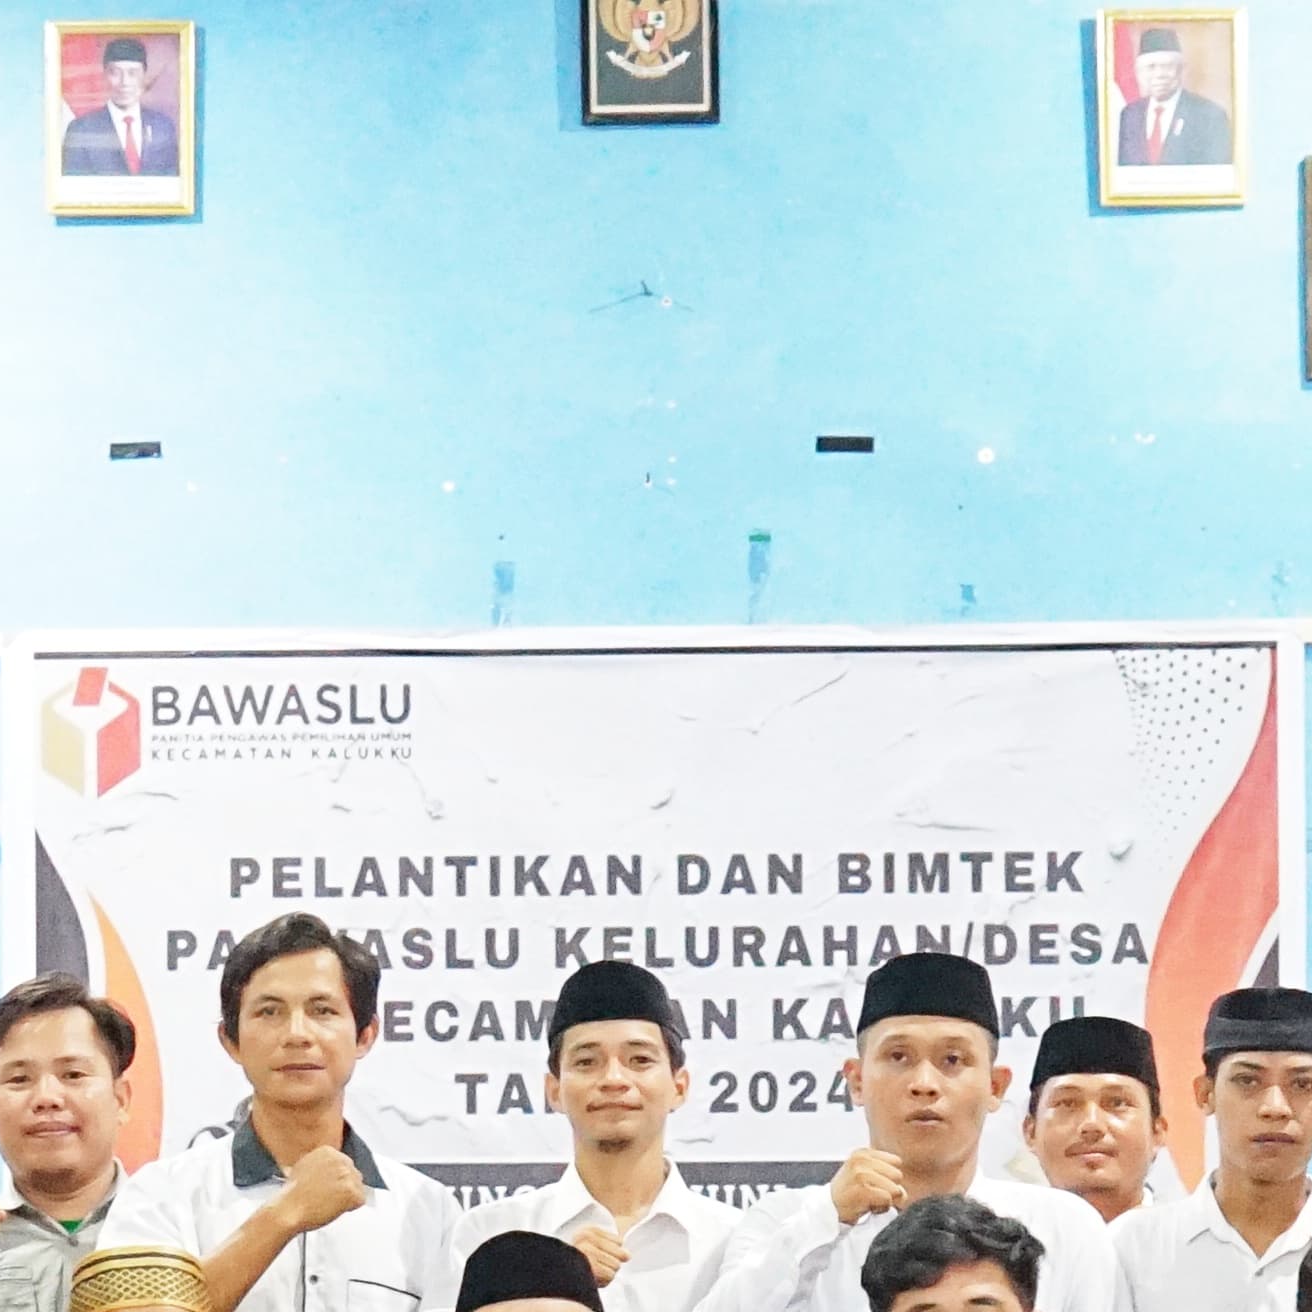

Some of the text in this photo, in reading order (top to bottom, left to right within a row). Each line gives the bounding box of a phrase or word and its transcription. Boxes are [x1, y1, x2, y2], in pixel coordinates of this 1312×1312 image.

[151, 684, 411, 726] BAWASLU
[151, 732, 412, 743] PANITIA PENGAWAS PEMILIHAN UMUM
[151, 747, 412, 761] KECAMATAN KALUKKU
[229, 849, 1086, 899] PELANTIKAN DAN BIMTEK
